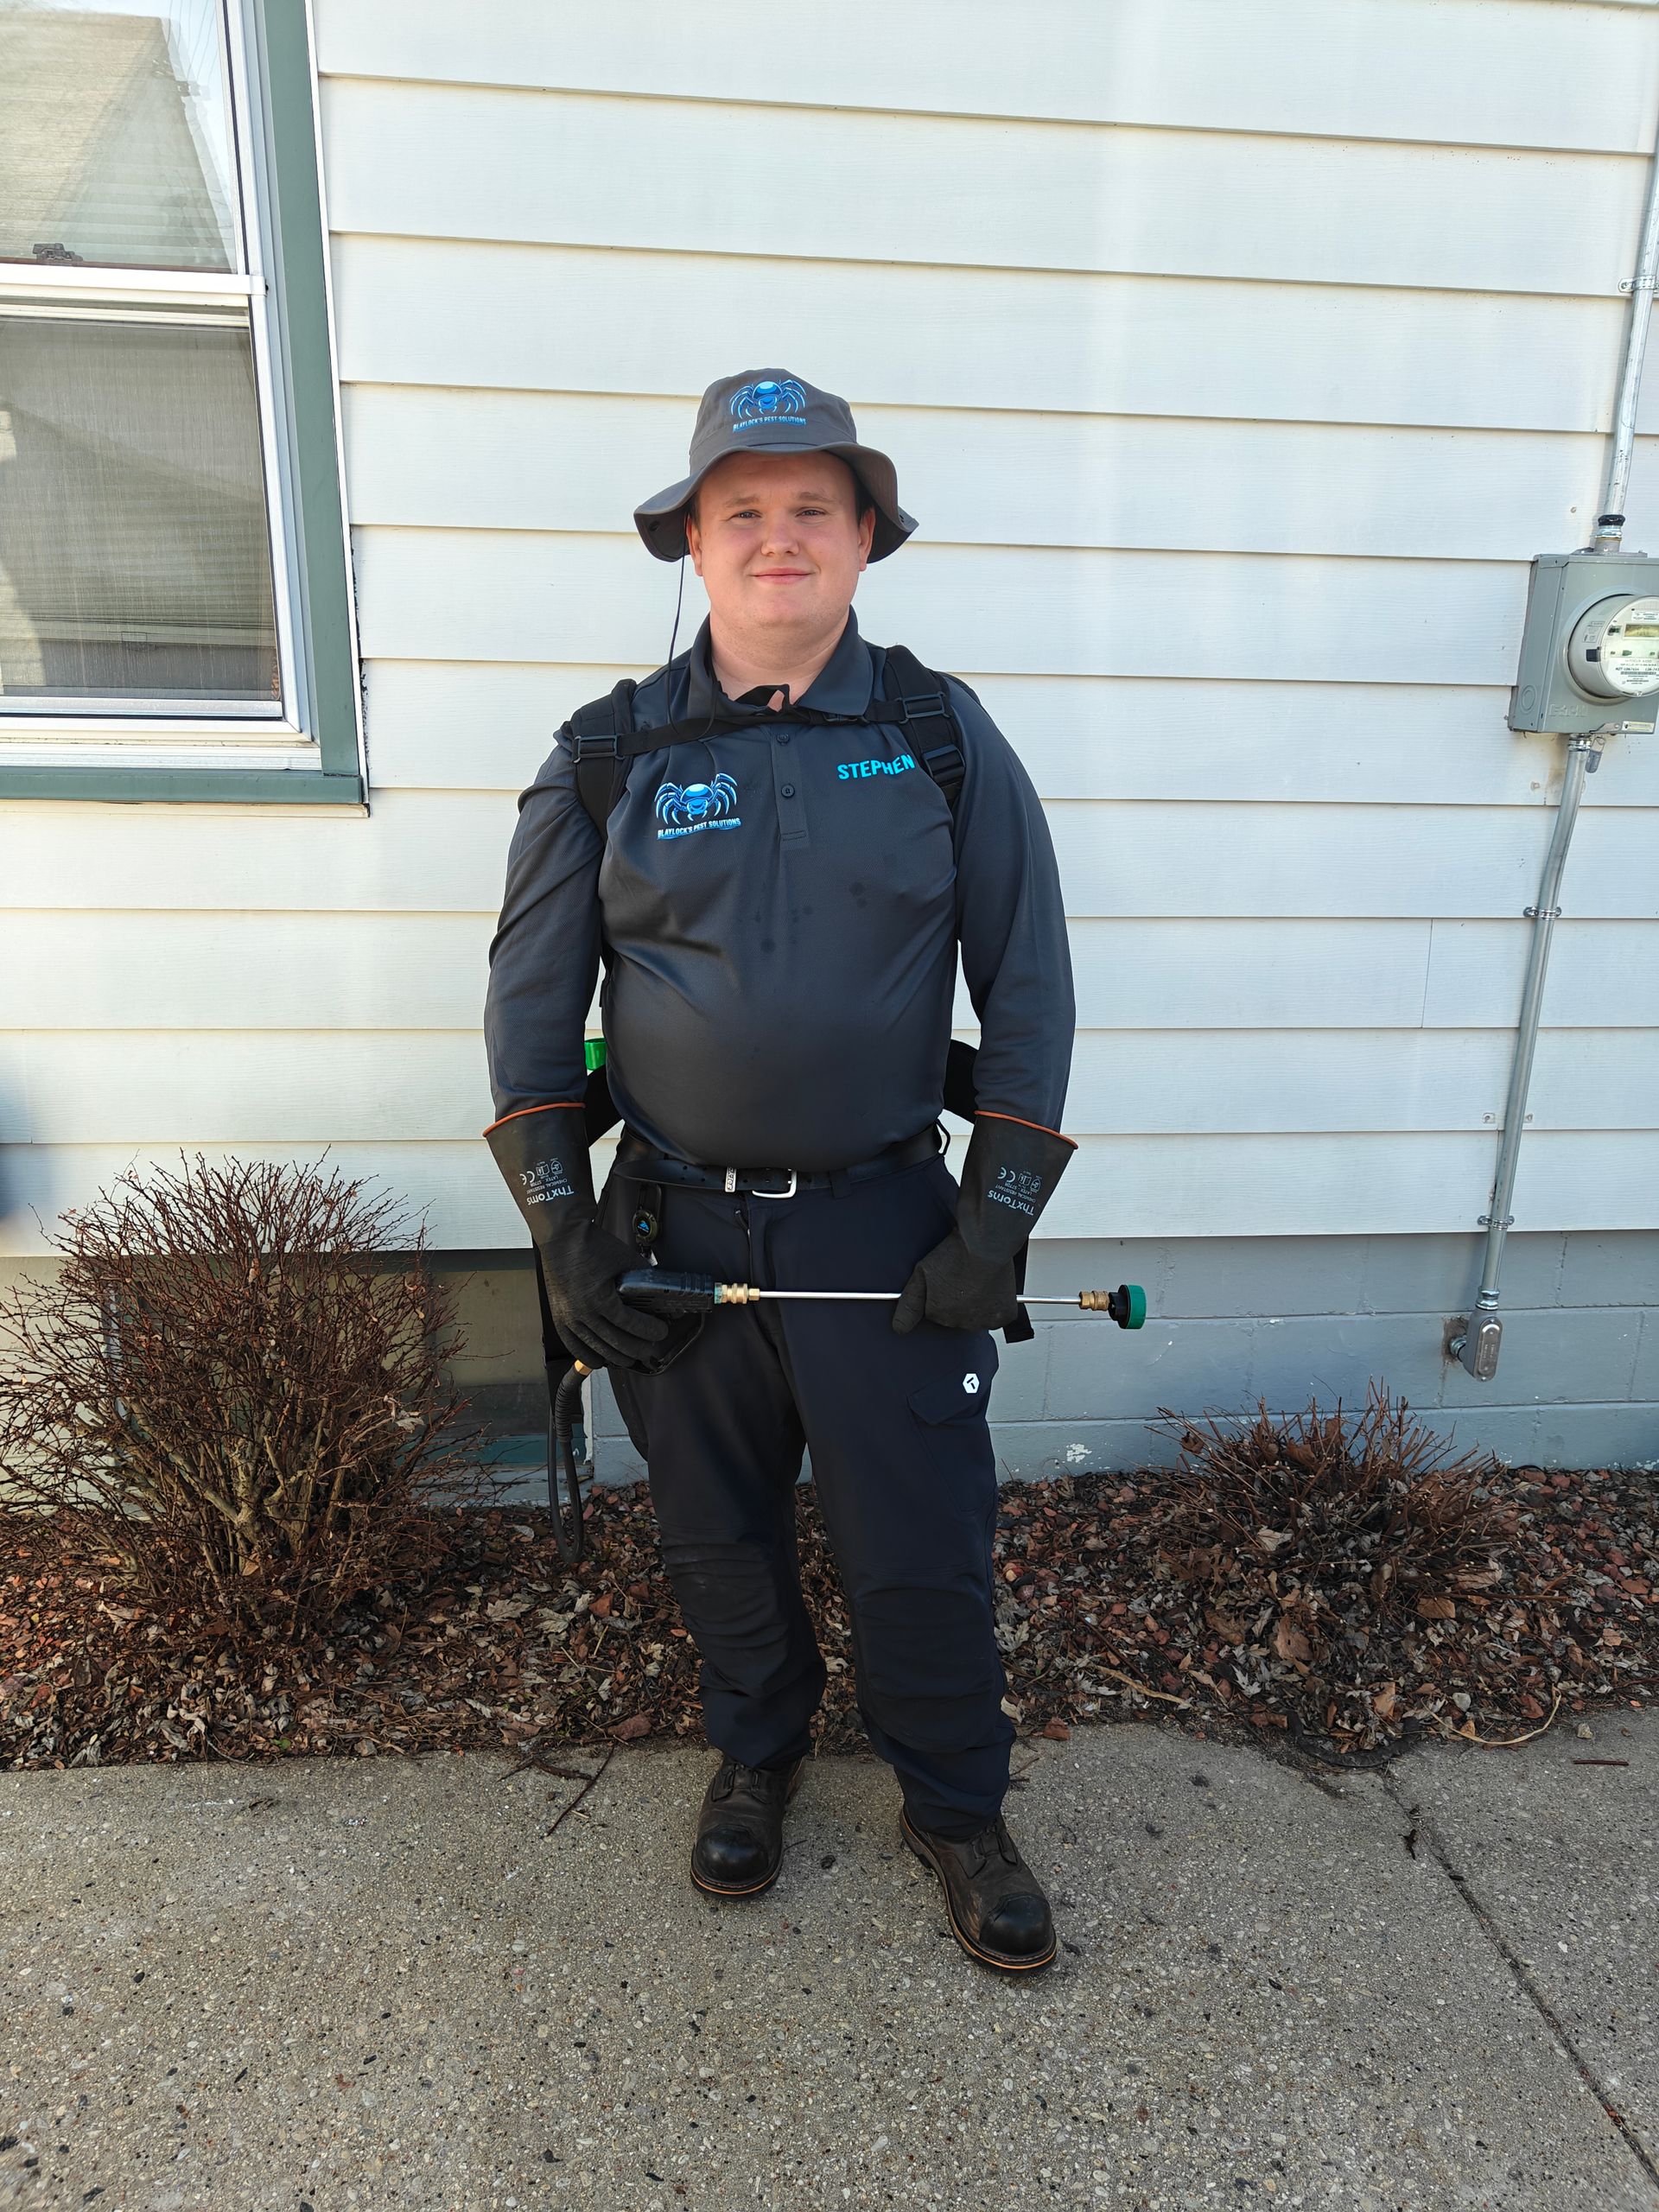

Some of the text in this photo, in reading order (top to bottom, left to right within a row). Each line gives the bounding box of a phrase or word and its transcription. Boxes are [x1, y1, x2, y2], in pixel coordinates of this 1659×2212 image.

[779, 416, 806, 425] SOLUTIONS
[837, 754, 915, 779] STEPHEN
[658, 817, 741, 838] BLAYLOCK'S PEST SOLUTIONS
[546, 1179, 568, 1188] CHEMICAL
[526, 1185, 574, 1205] ThxToms
[988, 1190, 1034, 1216] ThxToms
